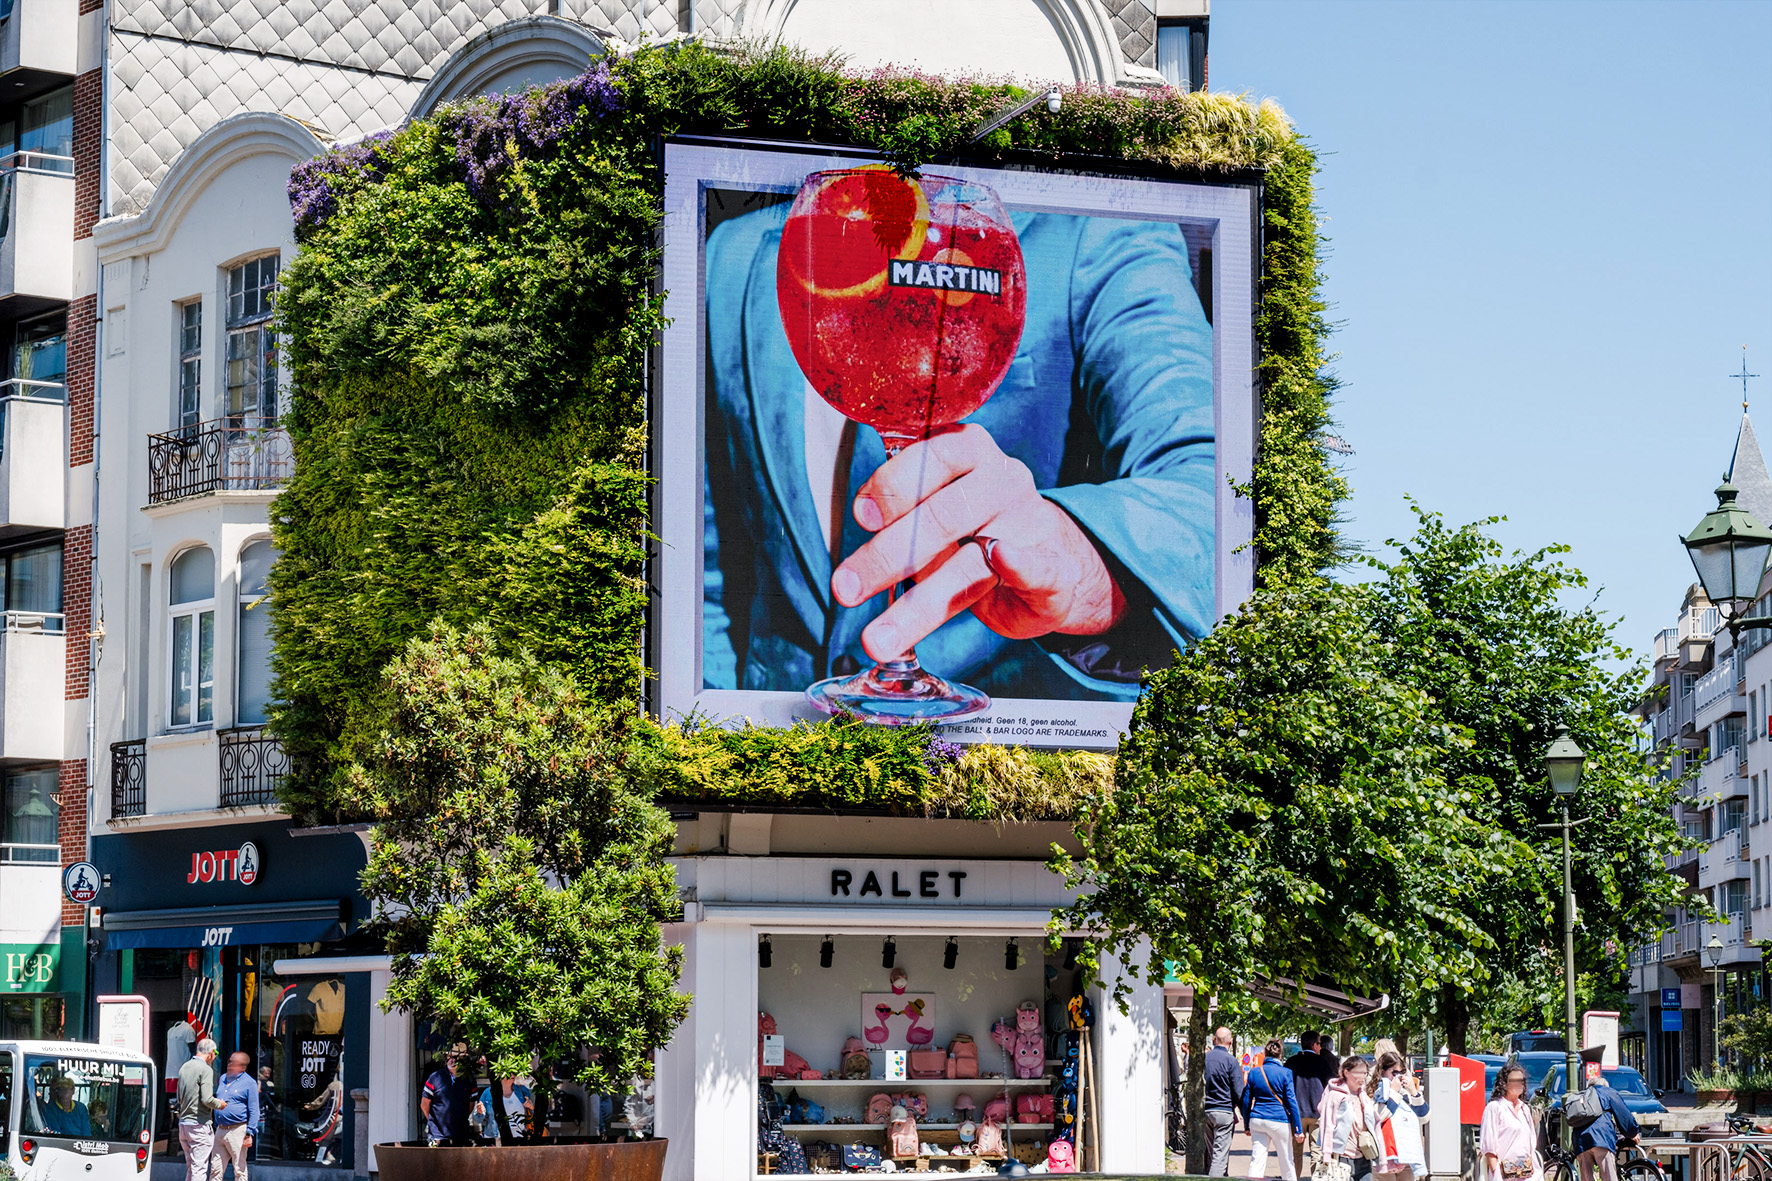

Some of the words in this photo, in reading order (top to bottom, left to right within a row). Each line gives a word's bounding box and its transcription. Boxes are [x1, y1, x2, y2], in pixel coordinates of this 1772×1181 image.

[893, 261, 1000, 294] MARTINI
[996, 716, 1016, 725] Geen
[1018, 717, 1028, 726] 18,
[1030, 718, 1049, 727] geen
[1050, 718, 1078, 727] alcohol.
[947, 725, 963, 734] THE
[986, 726, 991, 734] &
[993, 726, 1010, 735] BAR
[1011, 727, 1034, 736] LOGO
[1035, 728, 1052, 736] ARE
[1054, 728, 1109, 738] TRADEMARKS.
[187, 849, 240, 884] JOTT
[831, 869, 967, 898] RALET
[201, 927, 233, 947] JOTT
[5, 953, 54, 982] H&B
[302, 1040, 330, 1055] READY
[57, 1058, 100, 1075] HUUR
[103, 1063, 126, 1077] MIJ
[300, 1057, 326, 1073] JOTT
[301, 1073, 317, 1089] GO
